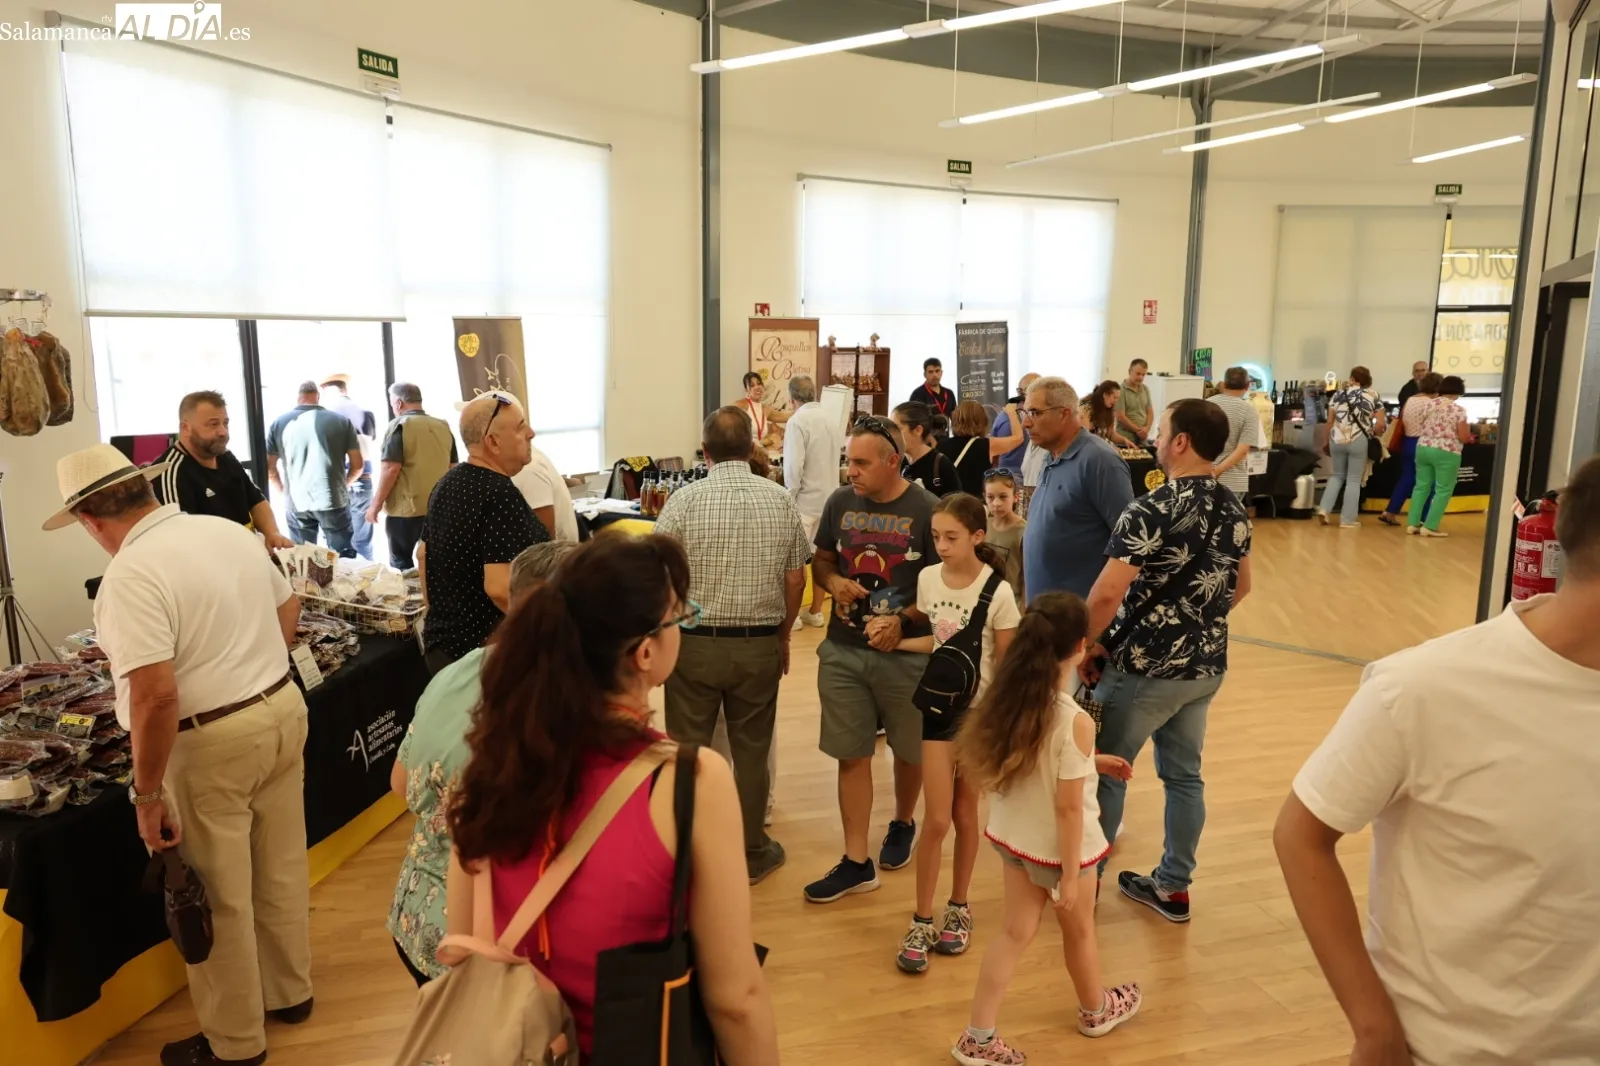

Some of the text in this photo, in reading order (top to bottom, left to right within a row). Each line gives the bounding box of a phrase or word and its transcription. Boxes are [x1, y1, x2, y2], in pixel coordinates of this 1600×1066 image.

[362, 53, 394, 73] SALIDA
[950, 162, 970, 172] SALIDA
[1438, 185, 1460, 193] SALIDA
[840, 511, 914, 536] SONIC
